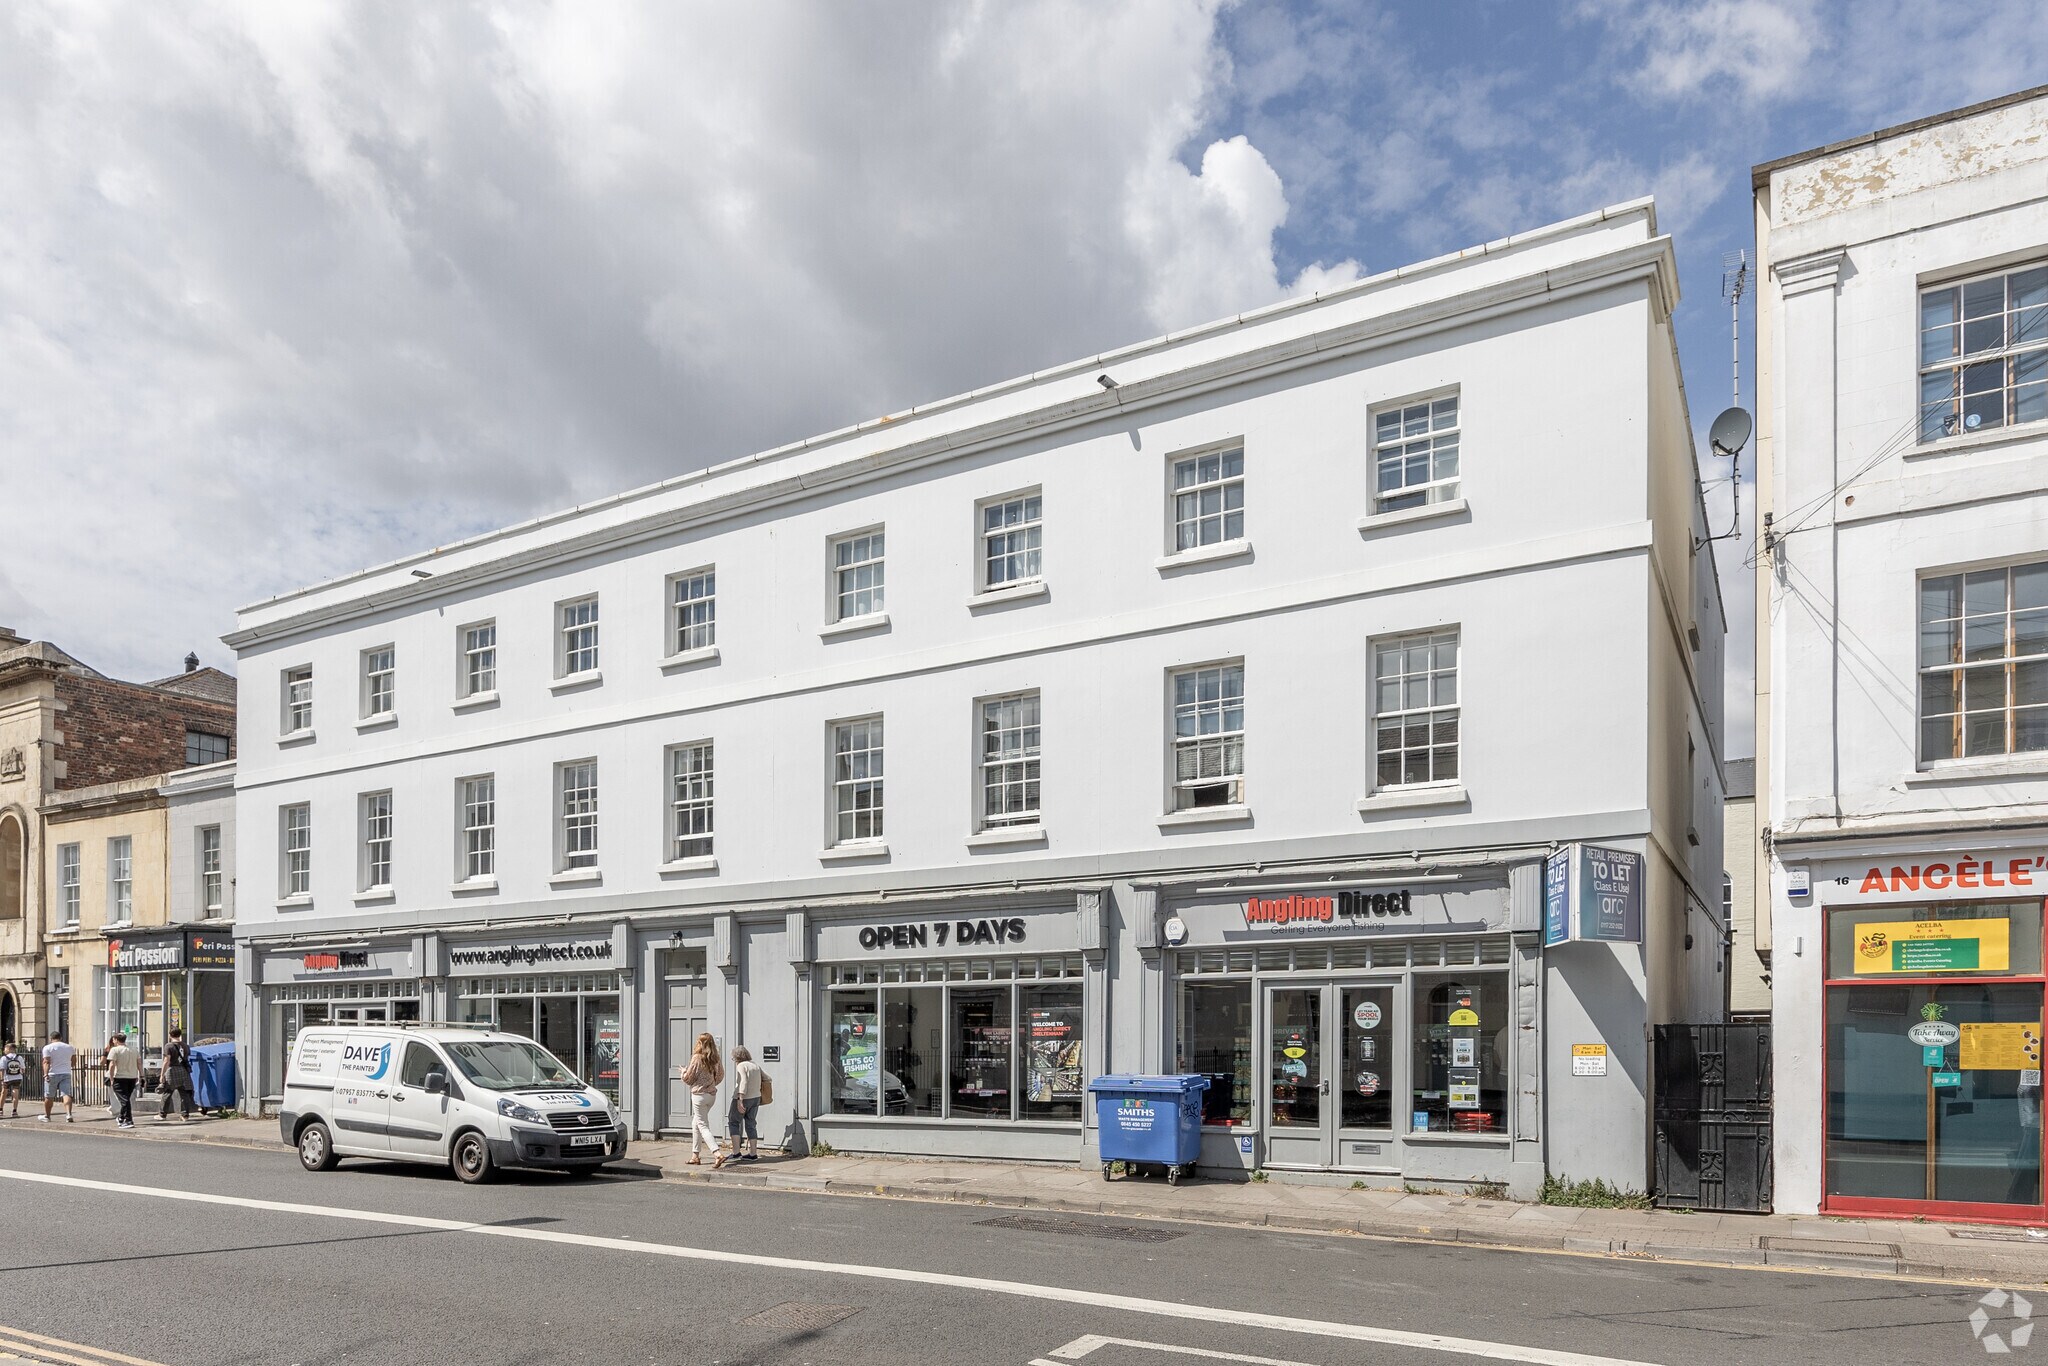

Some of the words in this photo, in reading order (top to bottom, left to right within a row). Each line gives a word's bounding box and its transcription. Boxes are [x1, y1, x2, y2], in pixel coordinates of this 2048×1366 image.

[1587, 848, 1606, 861] RETAIL
[1608, 851, 1636, 865] PREMISES
[1556, 863, 1566, 883] LET
[1592, 861, 1608, 880] TO
[1612, 864, 1631, 882] LET
[1834, 876, 1849, 886] 16
[1859, 854, 2048, 893] ANGÈLE'
[1613, 882, 1618, 892] E
[1247, 895, 1333, 922] Angling
[1338, 889, 1411, 915] Direct
[1602, 897, 1624, 915] arc
[859, 923, 927, 948] OPEN
[934, 922, 950, 945] 7
[957, 918, 1026, 943] DAYS
[1271, 925, 1302, 935] Getting
[1307, 924, 1349, 934] Everyone
[196, 941, 215, 950] Peri
[451, 941, 612, 966] www.anglingdirect.co.uk
[112, 944, 134, 968] Peri
[135, 942, 180, 966] Passion
[304, 953, 338, 971] Angling
[1913, 1028, 1931, 1036] Take
[1933, 1028, 1957, 1038] Away
[344, 1046, 380, 1061] DAVE
[842, 1057, 862, 1067] LET'S
[844, 1064, 873, 1073] FISHING
[1117, 1108, 1155, 1117] SMITHS
[575, 1136, 589, 1144] WN15
[590, 1135, 603, 1143] LXA
